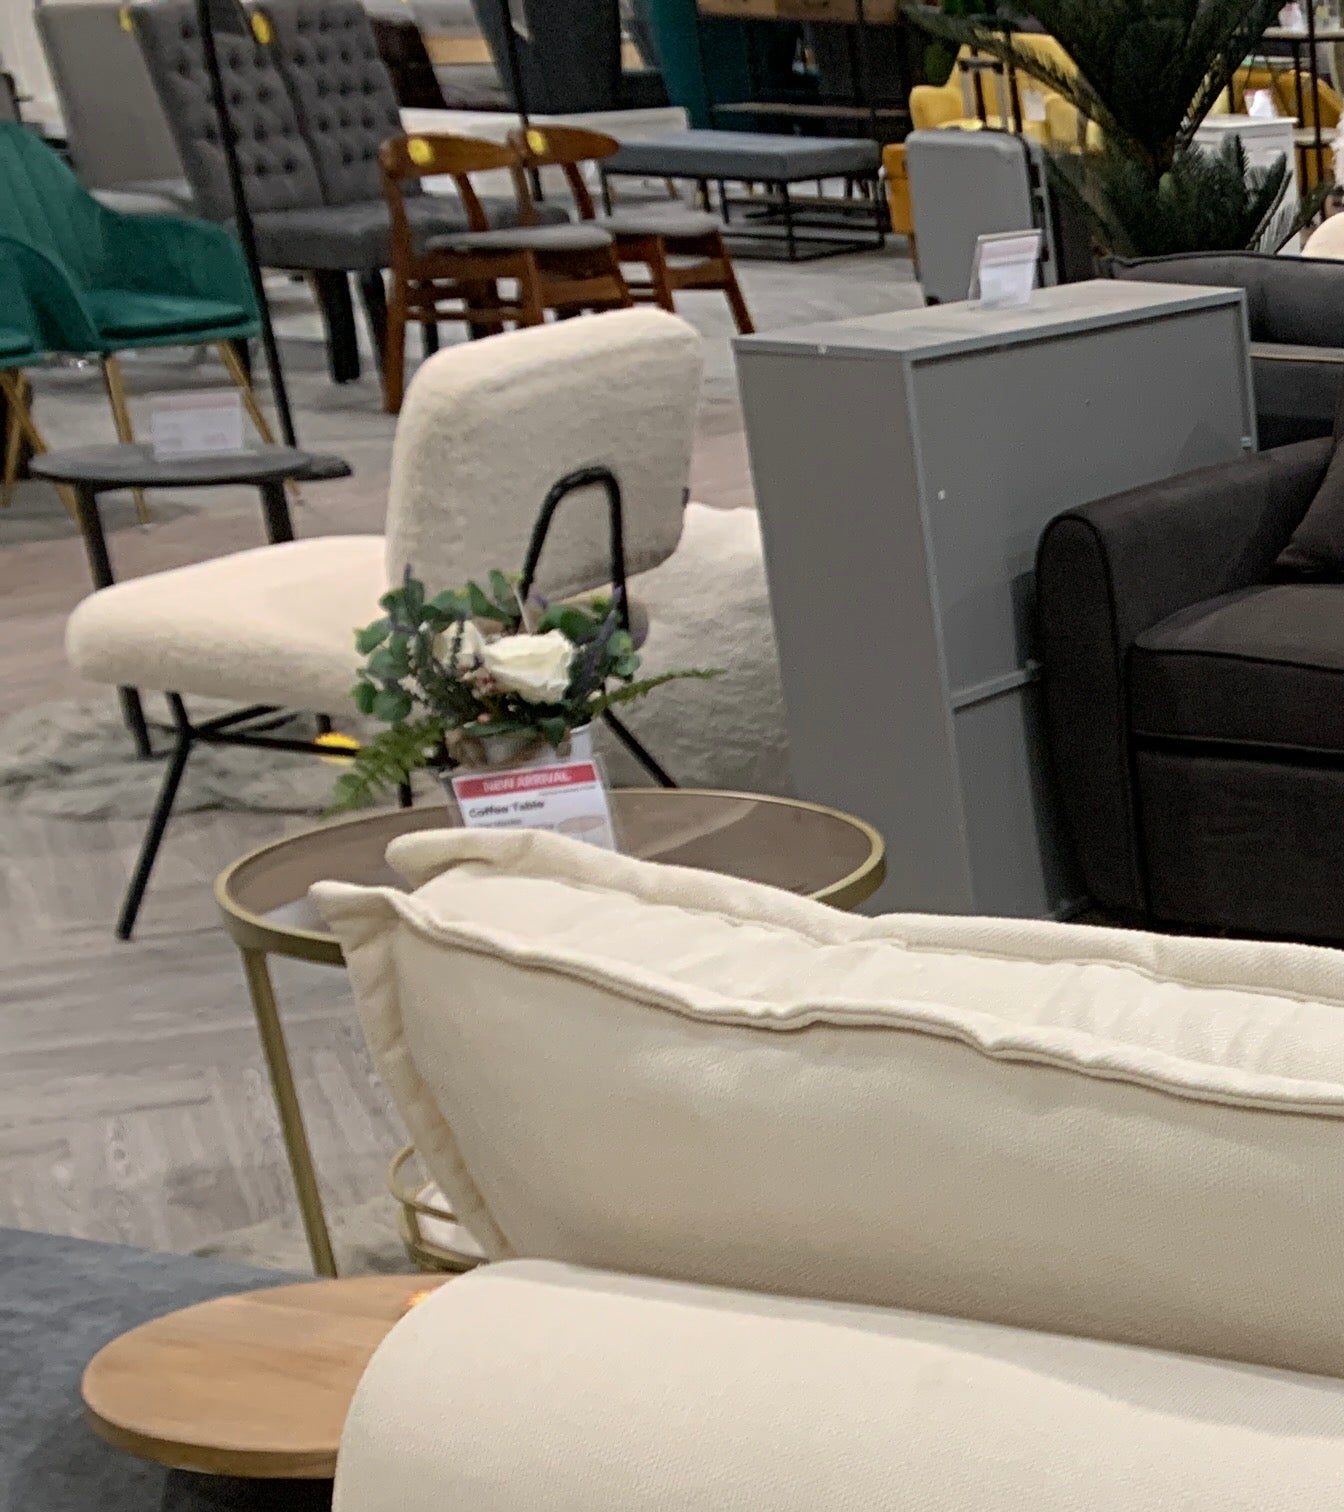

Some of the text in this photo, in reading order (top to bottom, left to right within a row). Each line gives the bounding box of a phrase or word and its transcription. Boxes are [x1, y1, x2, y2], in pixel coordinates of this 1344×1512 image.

[482, 771, 572, 793] NEW ARRIVAL
[468, 799, 545, 819] Coffee Table
